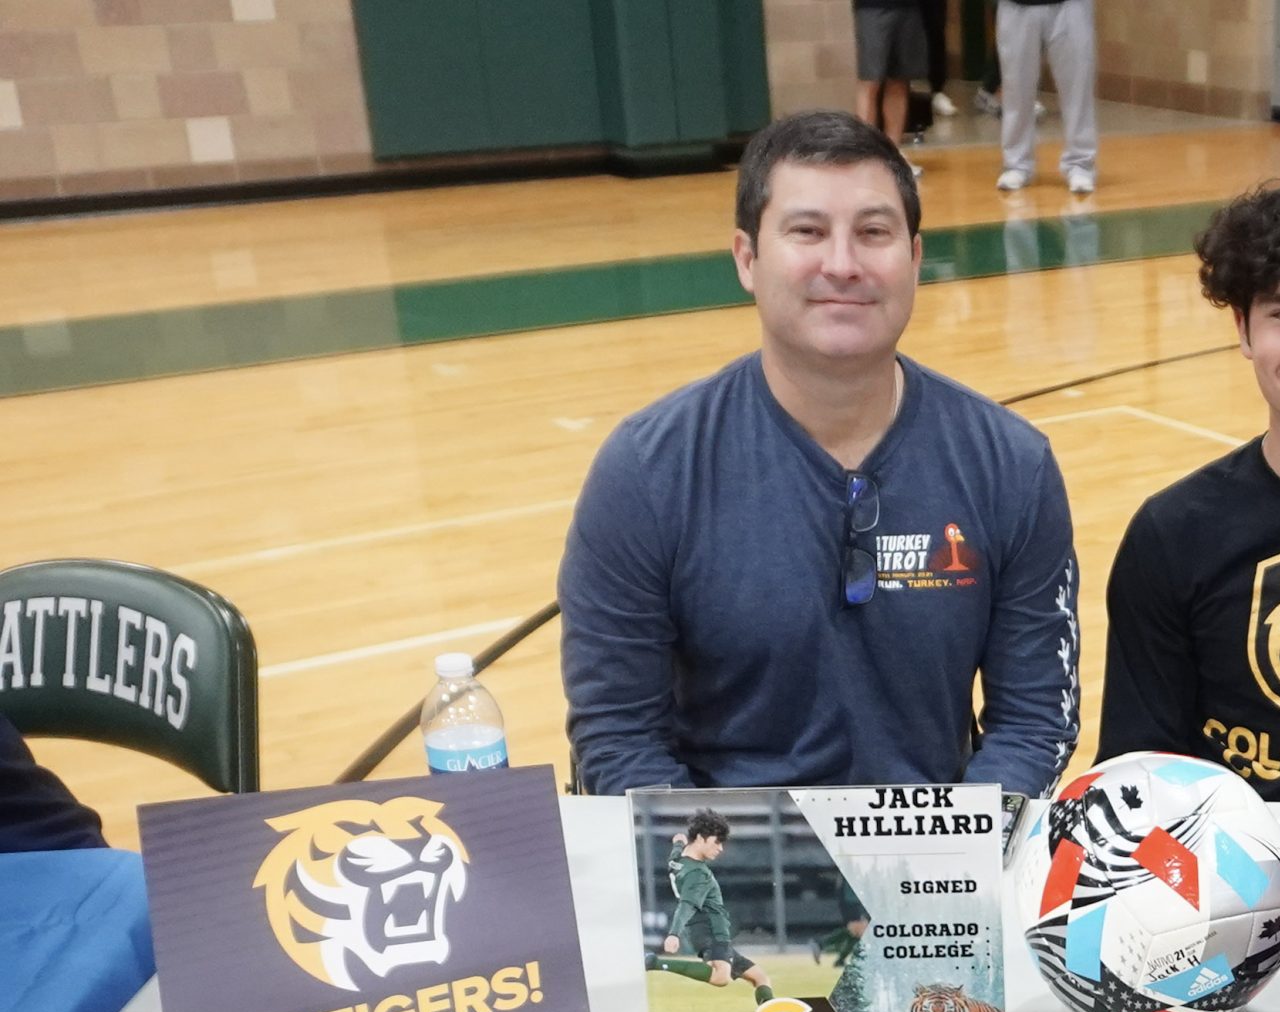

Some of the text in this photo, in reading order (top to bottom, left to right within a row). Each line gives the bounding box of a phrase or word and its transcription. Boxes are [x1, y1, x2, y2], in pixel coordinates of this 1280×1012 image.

[881, 534, 931, 551] TURKEY
[883, 550, 928, 571] TROT
[446, 750, 503, 771] GLACIER
[868, 788, 954, 809] JACK
[834, 814, 993, 837] HILLIARD
[900, 880, 977, 894] SIGNED
[873, 923, 979, 938] COLORADO
[883, 944, 975, 959] COLLEGE
[1174, 949, 1186, 961] 21
[1187, 974, 1229, 997] adidas
